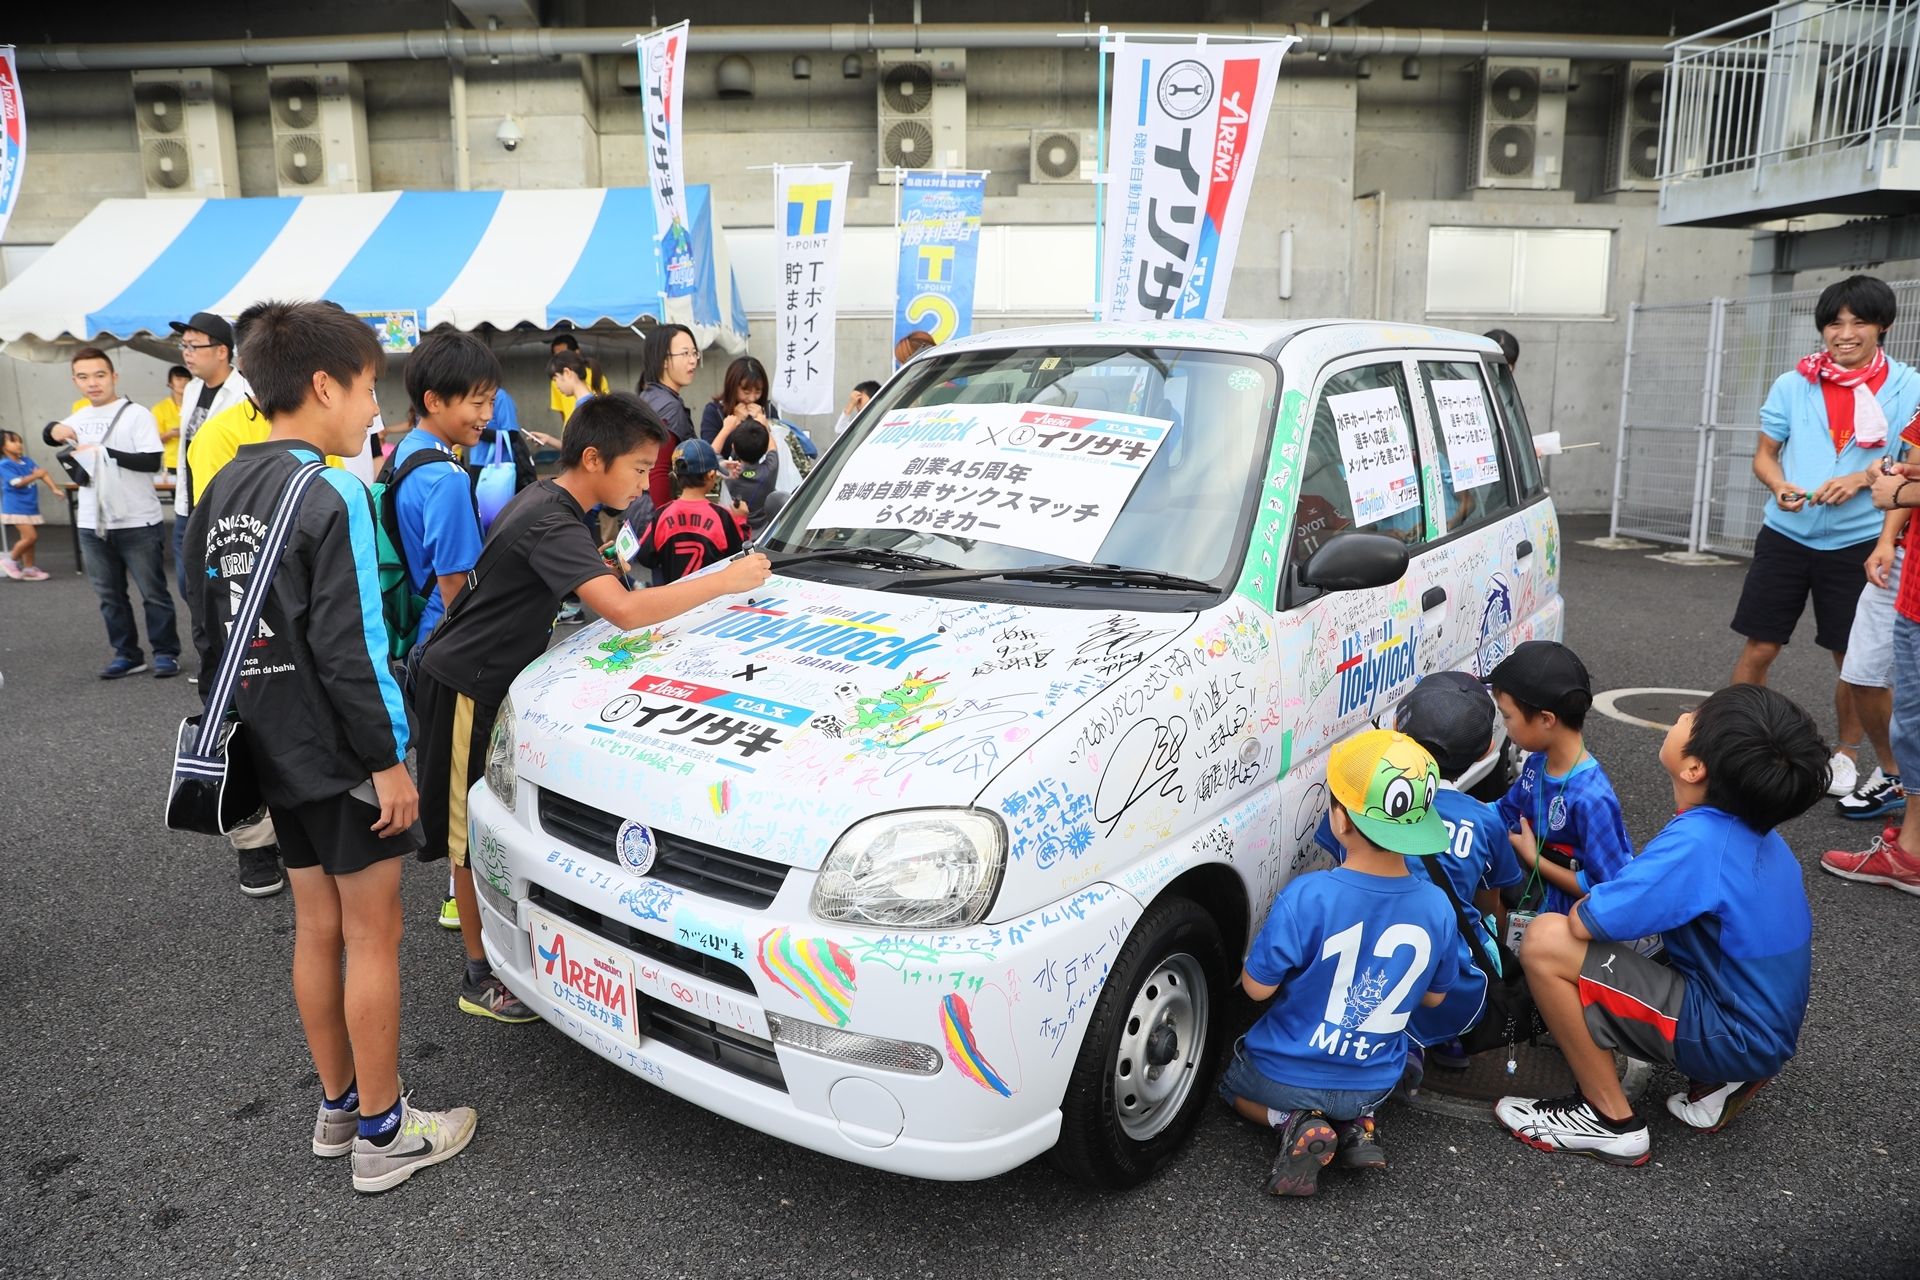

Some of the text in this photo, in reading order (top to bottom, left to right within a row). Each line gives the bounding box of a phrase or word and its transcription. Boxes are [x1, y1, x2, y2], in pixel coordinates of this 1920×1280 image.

[650, 75, 674, 207] イソザキ
[1212, 91, 1249, 183] ARENA
[785, 239, 828, 250] T-POINT
[915, 283, 952, 292] T-POINT
[1183, 256, 1208, 317] TA
[784, 262, 804, 394] 貯まります。
[803, 261, 829, 381] Tポイント
[1032, 412, 1150, 437] ARENA TAX
[1336, 404, 1400, 432] 水戸ホーリーホックの
[1036, 430, 1153, 461] イソザキ
[1353, 427, 1391, 451] 選手へ応援
[902, 456, 1032, 485] 創業45周年
[665, 513, 714, 531] PUMA
[875, 503, 1001, 533] らくがきカー
[674, 541, 706, 577] 7
[791, 655, 861, 675] IBARAKI
[645, 680, 789, 720] ARENA TAX
[633, 704, 784, 758] イソザキ
[537, 933, 627, 1017] ARENA
[593, 957, 623, 979] SUZUKI
[1321, 921, 1431, 1034] 12
[552, 981, 625, 1033] ひたちなか東
